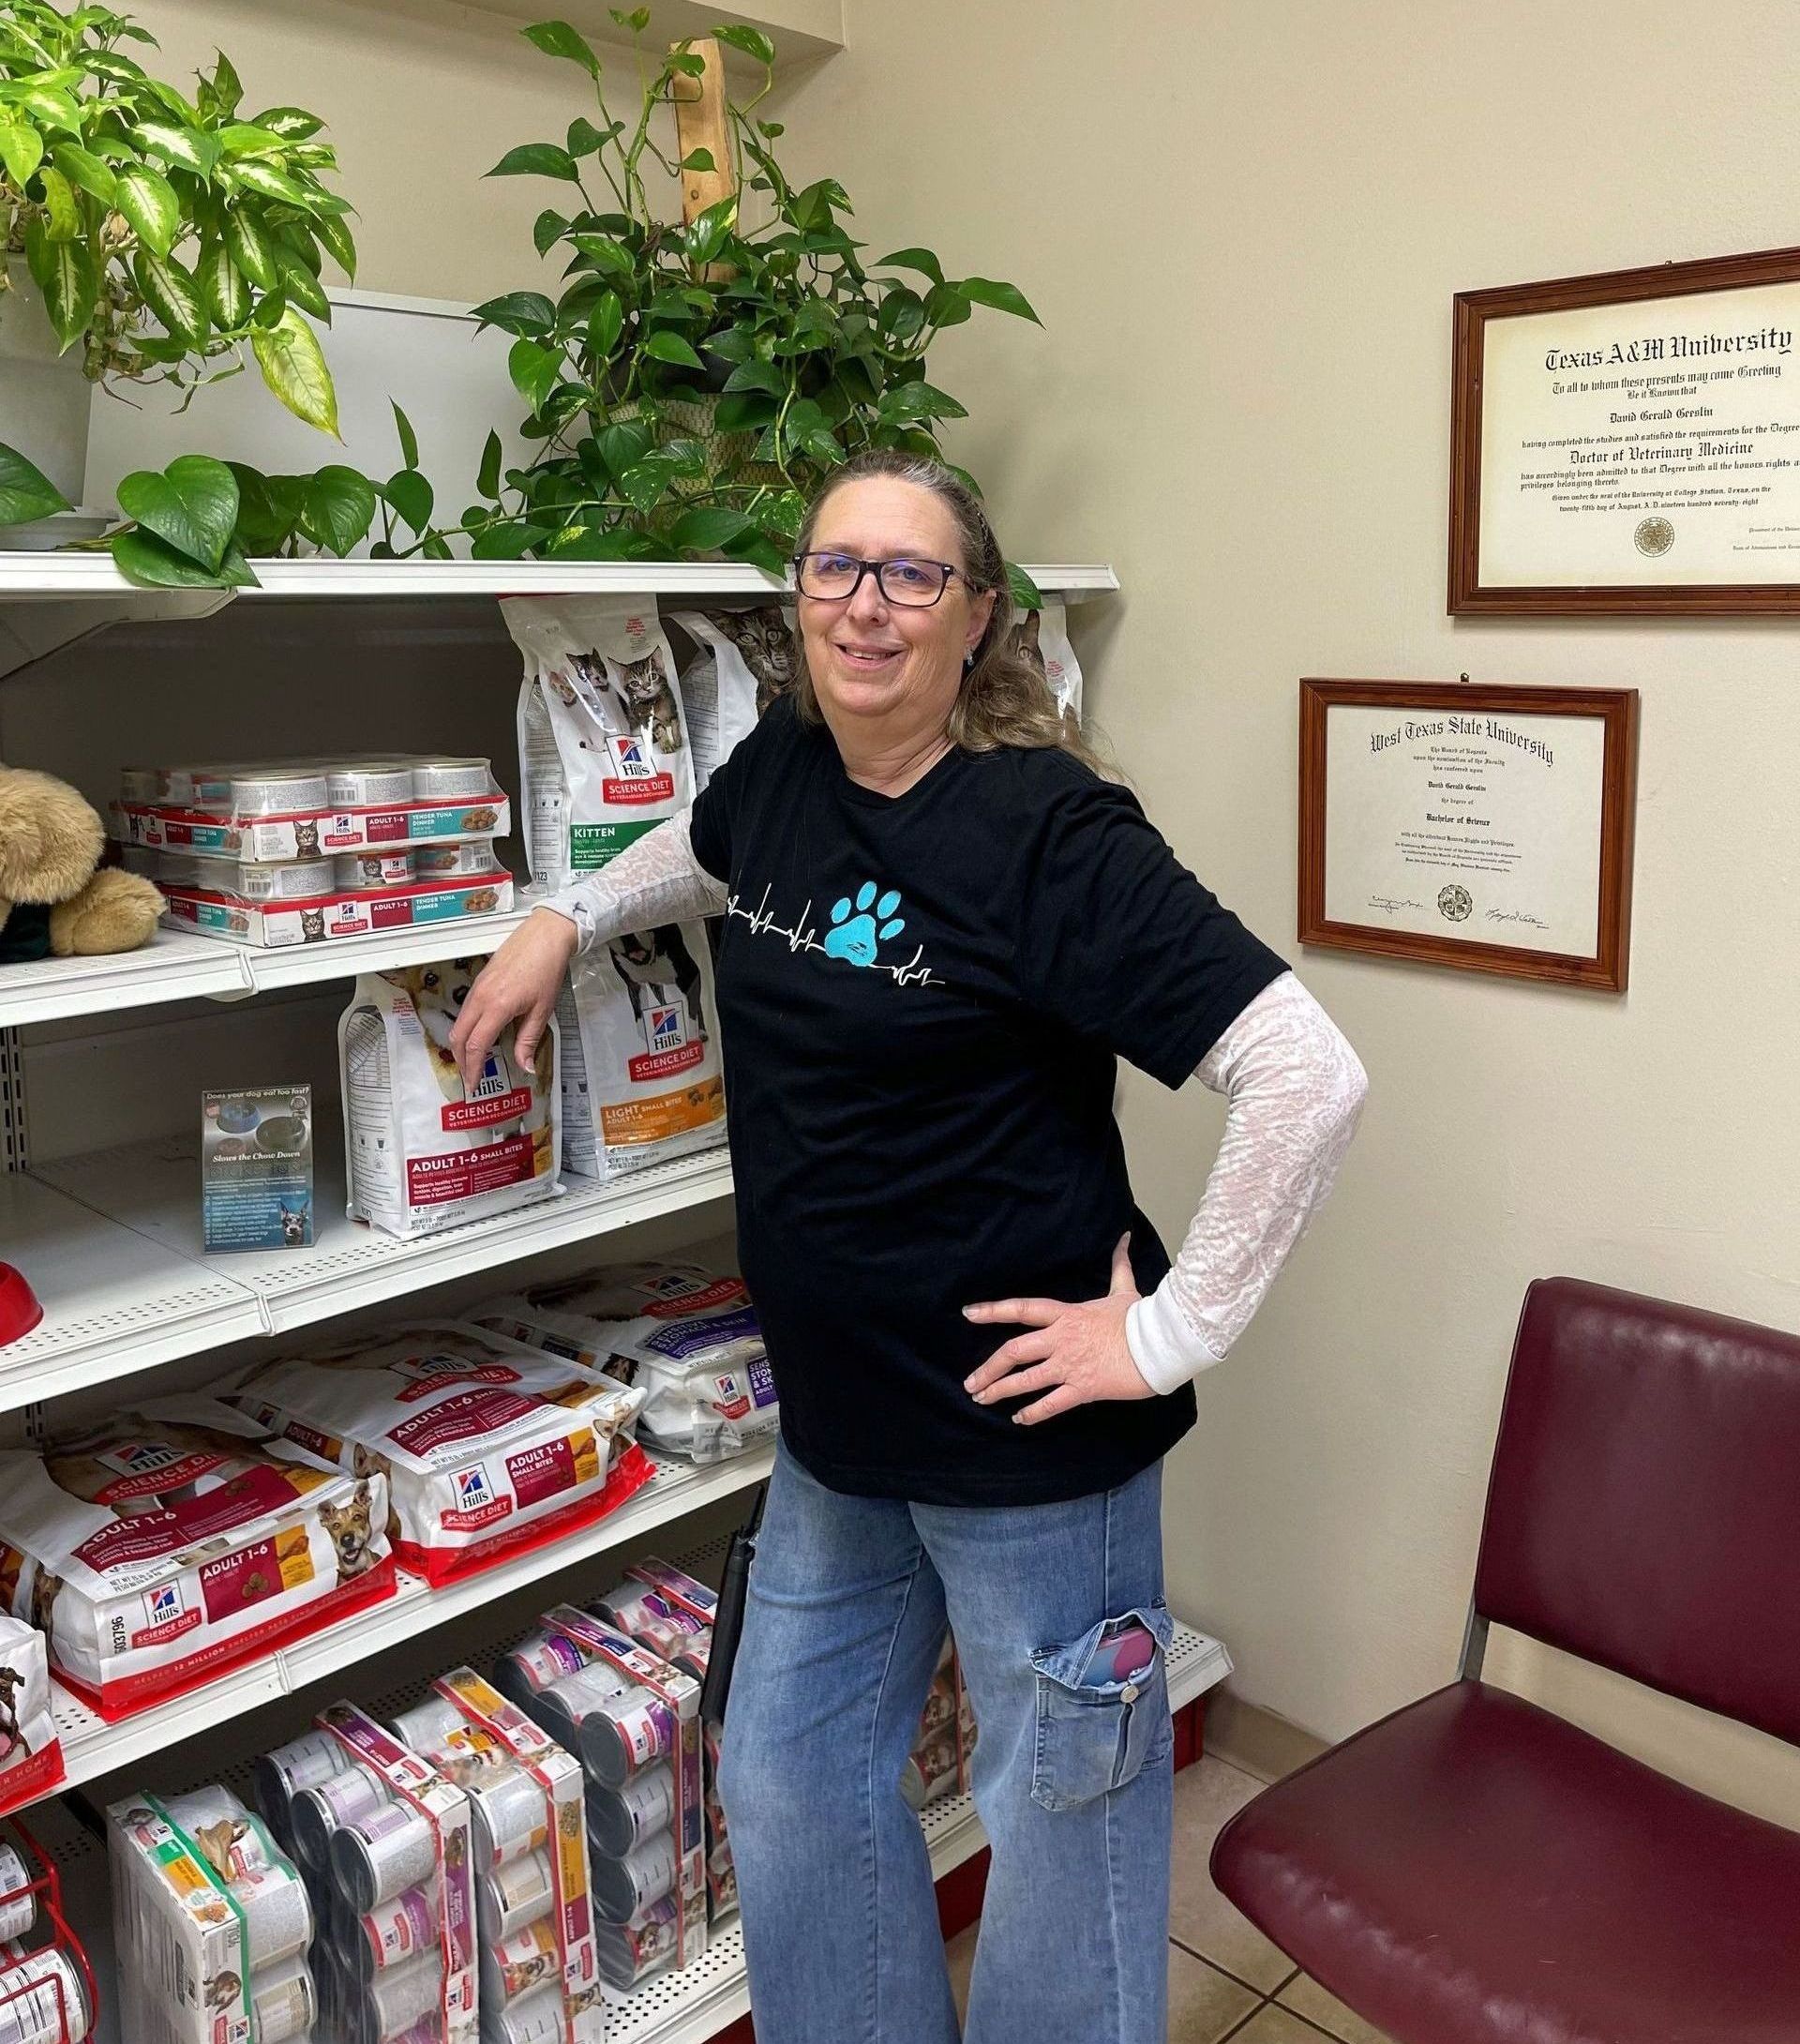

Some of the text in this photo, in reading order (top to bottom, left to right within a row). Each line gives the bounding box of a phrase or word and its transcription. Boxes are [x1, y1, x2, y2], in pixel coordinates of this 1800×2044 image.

[1545, 348, 1603, 374] Texas
[1669, 327, 1792, 357] University
[1552, 365, 1781, 395] To all to whom these presents may come Greeting
[1681, 385, 1697, 395] that
[1610, 412, 1637, 423] David
[1640, 409, 1672, 422] Gerald
[1522, 440, 1547, 449] having
[1548, 437, 1582, 448] completed
[1583, 436, 1595, 444] the
[1596, 435, 1623, 444] studies
[1625, 433, 1640, 443] and
[1641, 431, 1673, 441] satisfied
[1675, 430, 1687, 439] the
[1688, 428, 1740, 440] requirements
[1741, 426, 1753, 435] for
[1755, 425, 1768, 434] the
[1569, 441, 1754, 464] Doctor of Veterinary Medicine
[1521, 472, 1535, 480] has
[1536, 470, 1576, 480] accordingly
[1577, 469, 1594, 478] been
[1596, 467, 1628, 477] admitted
[1641, 466, 1657, 474] that
[1659, 464, 1686, 475] Degree
[1688, 462, 1705, 473] with
[1707, 461, 1718, 471] all
[1720, 460, 1732, 470] the
[1765, 458, 1791, 470] rights
[1521, 479, 1593, 491] privileges belonging
[1371, 716, 1553, 768] West Texas State University
[622, 763, 651, 776] Hill's
[608, 779, 669, 795] SCIENCE DIET
[369, 816, 404, 825] ADULT 1-6
[1426, 812, 1492, 827] Bachelor of Science
[574, 827, 615, 838] KITTEN
[374, 902, 396, 911] ADULT
[653, 1033, 682, 1051] Hill's
[635, 1046, 699, 1073] SCIENCE DIET
[227, 1091, 244, 1100] your
[246, 1090, 262, 1098] dog
[448, 1093, 526, 1121] SCIENCE DIET
[606, 1105, 639, 1120] LIGHT
[641, 1102, 664, 1112] SMALL
[238, 1152, 252, 1161] the
[276, 1150, 301, 1159] Down
[412, 1157, 455, 1173] ADULT
[458, 1152, 478, 1165] 1-6
[480, 1150, 503, 1162] SMALL
[504, 1143, 523, 1154] BITES
[709, 1281, 736, 1296] DIET
[473, 1368, 506, 1381] DIET
[753, 1380, 760, 1389] &
[396, 1405, 444, 1438] ADULT
[446, 1396, 473, 1410] 1-6
[510, 1448, 544, 1471] ADULT
[547, 1441, 564, 1454] 1-6
[512, 1465, 535, 1479] SMALL
[535, 1458, 554, 1469] BITES
[106, 1463, 188, 1498] SCIENCE
[462, 1491, 489, 1509] Hill's
[144, 1511, 177, 1525] 1-6
[445, 1500, 509, 1525] SCIENCE DIET
[202, 1544, 269, 1580] ADULT 1-6
[153, 1606, 180, 1624] Hill's
[136, 1613, 199, 1644] SCIENCE DIET
[188, 1646, 227, 1667] MILLION
